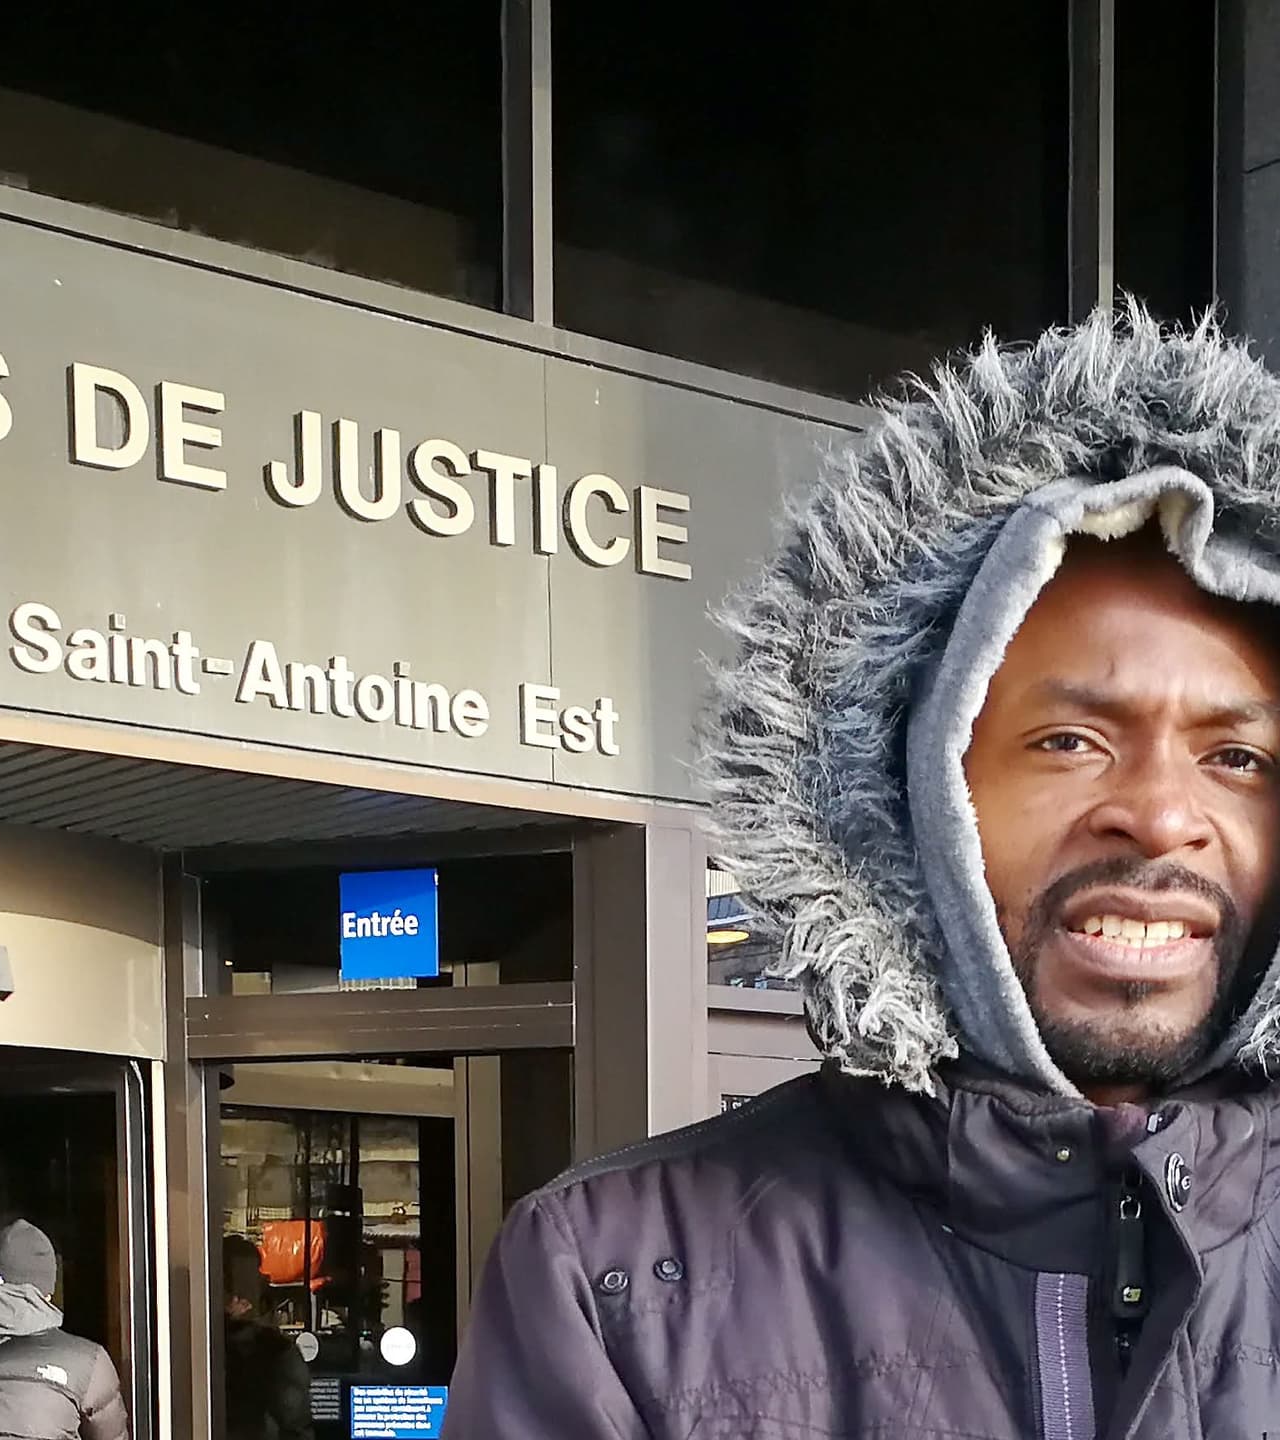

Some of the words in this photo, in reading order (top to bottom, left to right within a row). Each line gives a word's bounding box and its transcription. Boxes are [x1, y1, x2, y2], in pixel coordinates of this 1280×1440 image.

[70, 362, 227, 490] DE
[264, 410, 693, 581] JUSTICE
[9, 602, 489, 737] Saint-Antoine
[521, 682, 621, 757] Est
[342, 909, 418, 938] Entrée
